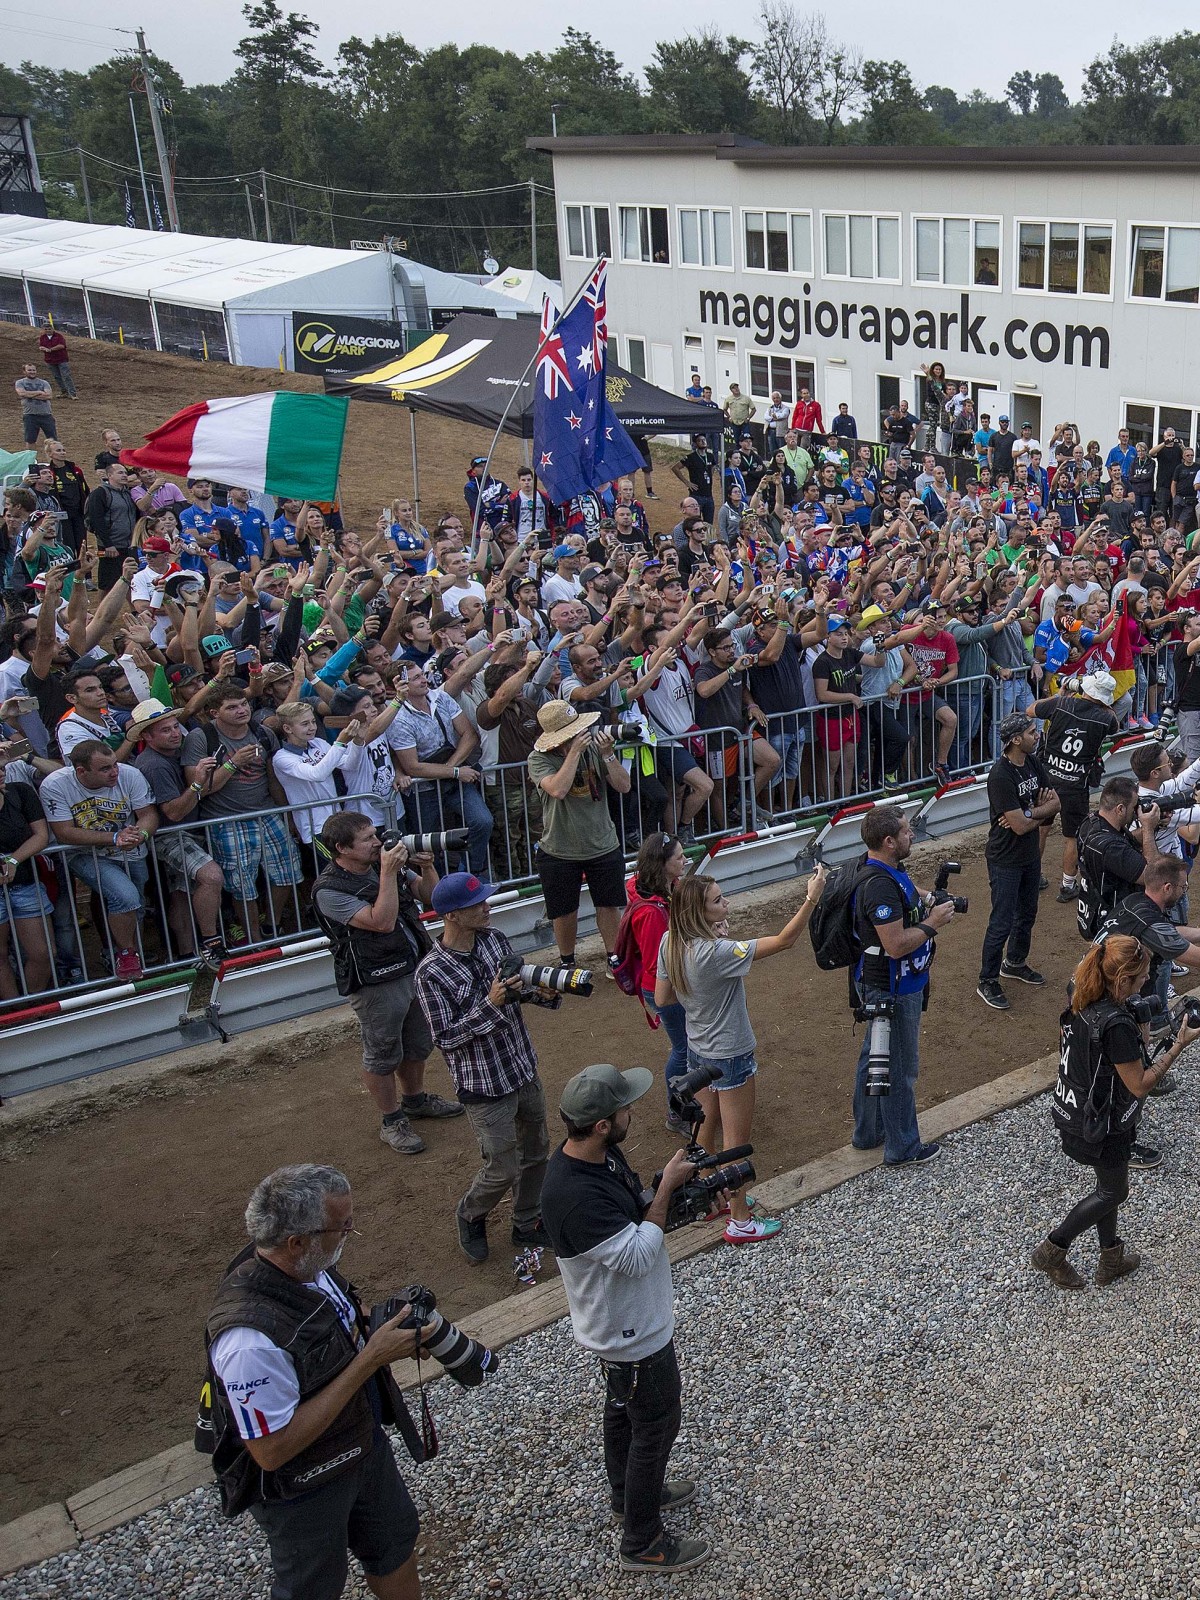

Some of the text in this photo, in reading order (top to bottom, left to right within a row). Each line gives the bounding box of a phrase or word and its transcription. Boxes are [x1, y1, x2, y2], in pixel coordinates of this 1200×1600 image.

[699, 282, 1111, 369] maggiorapark.com
[333, 346, 366, 356] PARK
[336, 335, 400, 349] MAGGIORA
[1061, 736, 1084, 757] 69
[1047, 754, 1086, 774] MEDIA
[227, 1376, 271, 1392] FRANCE
